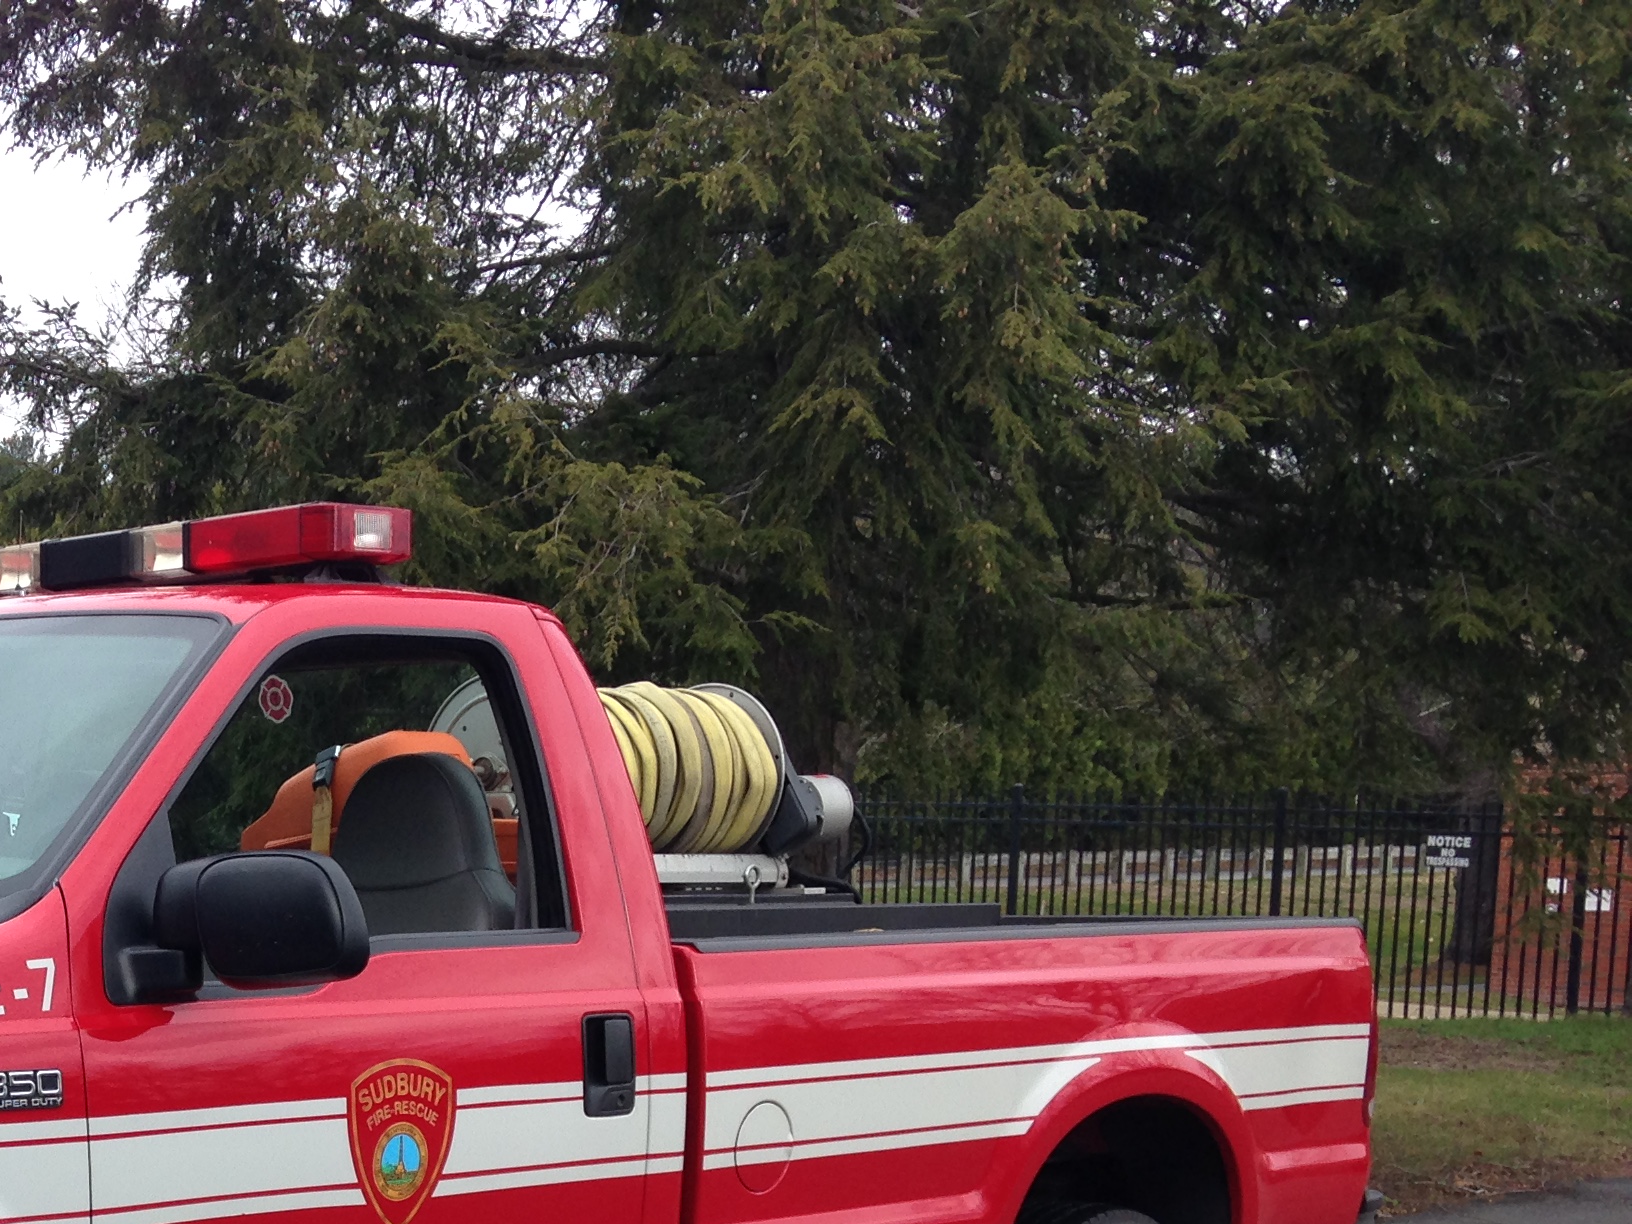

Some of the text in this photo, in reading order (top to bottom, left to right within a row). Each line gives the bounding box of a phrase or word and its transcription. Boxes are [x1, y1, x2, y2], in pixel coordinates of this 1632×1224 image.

[1427, 835, 1472, 848] NOTICE
[1440, 848, 1456, 857] NO
[358, 1072, 447, 1112] SUDBURY
[31, 1097, 63, 1107] DUTY
